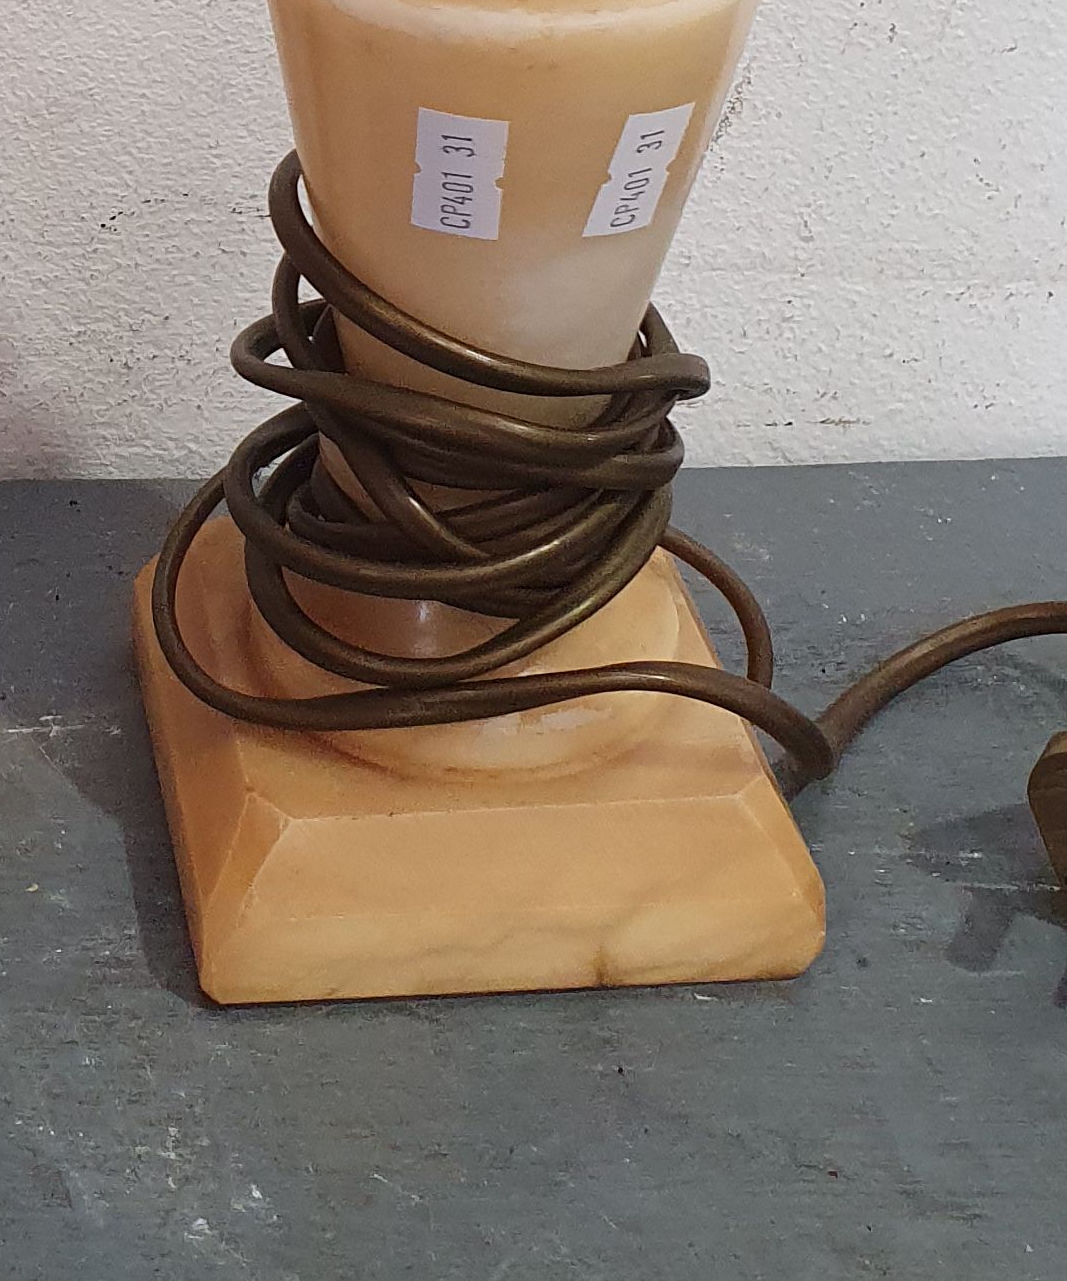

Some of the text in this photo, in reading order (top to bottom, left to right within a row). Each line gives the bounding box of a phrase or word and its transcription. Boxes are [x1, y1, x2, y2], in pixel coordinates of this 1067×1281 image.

[439, 134, 476, 230] CP401 31
[609, 128, 666, 229] CP401 31
